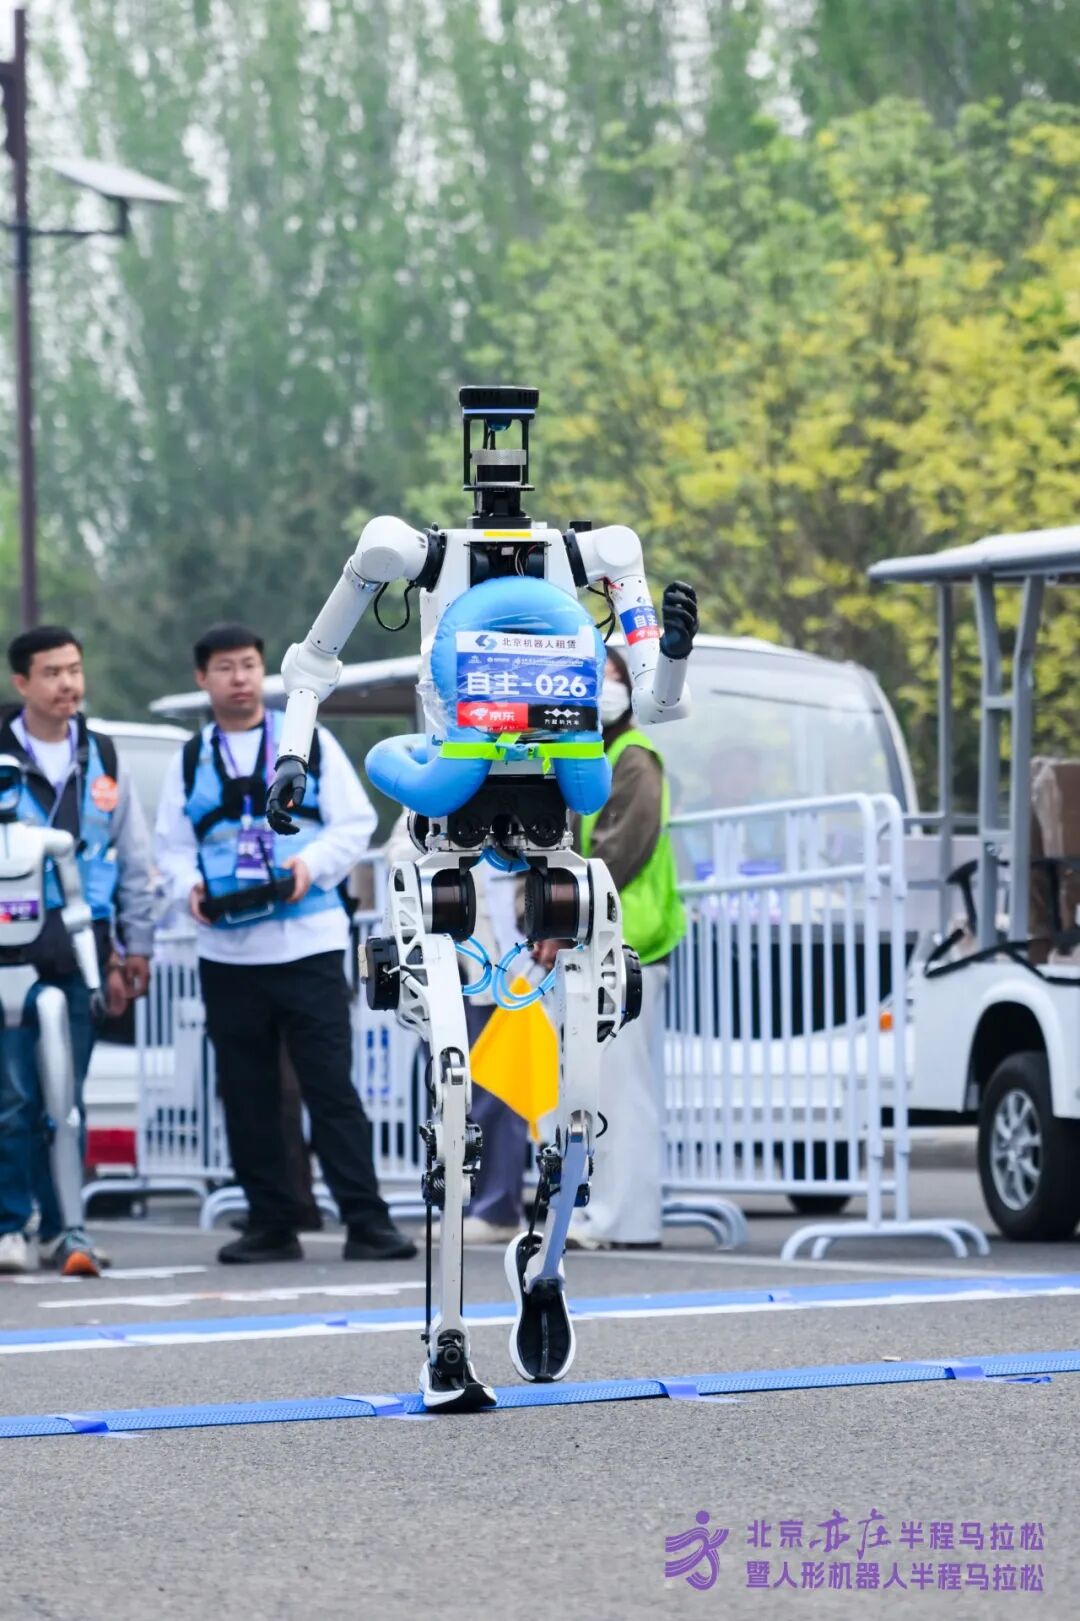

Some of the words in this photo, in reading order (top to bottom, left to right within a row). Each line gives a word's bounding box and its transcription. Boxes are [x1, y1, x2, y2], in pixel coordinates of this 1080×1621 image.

[502, 637, 577, 649] 北京机器人租赁
[467, 672, 587, 697] 自主-026
